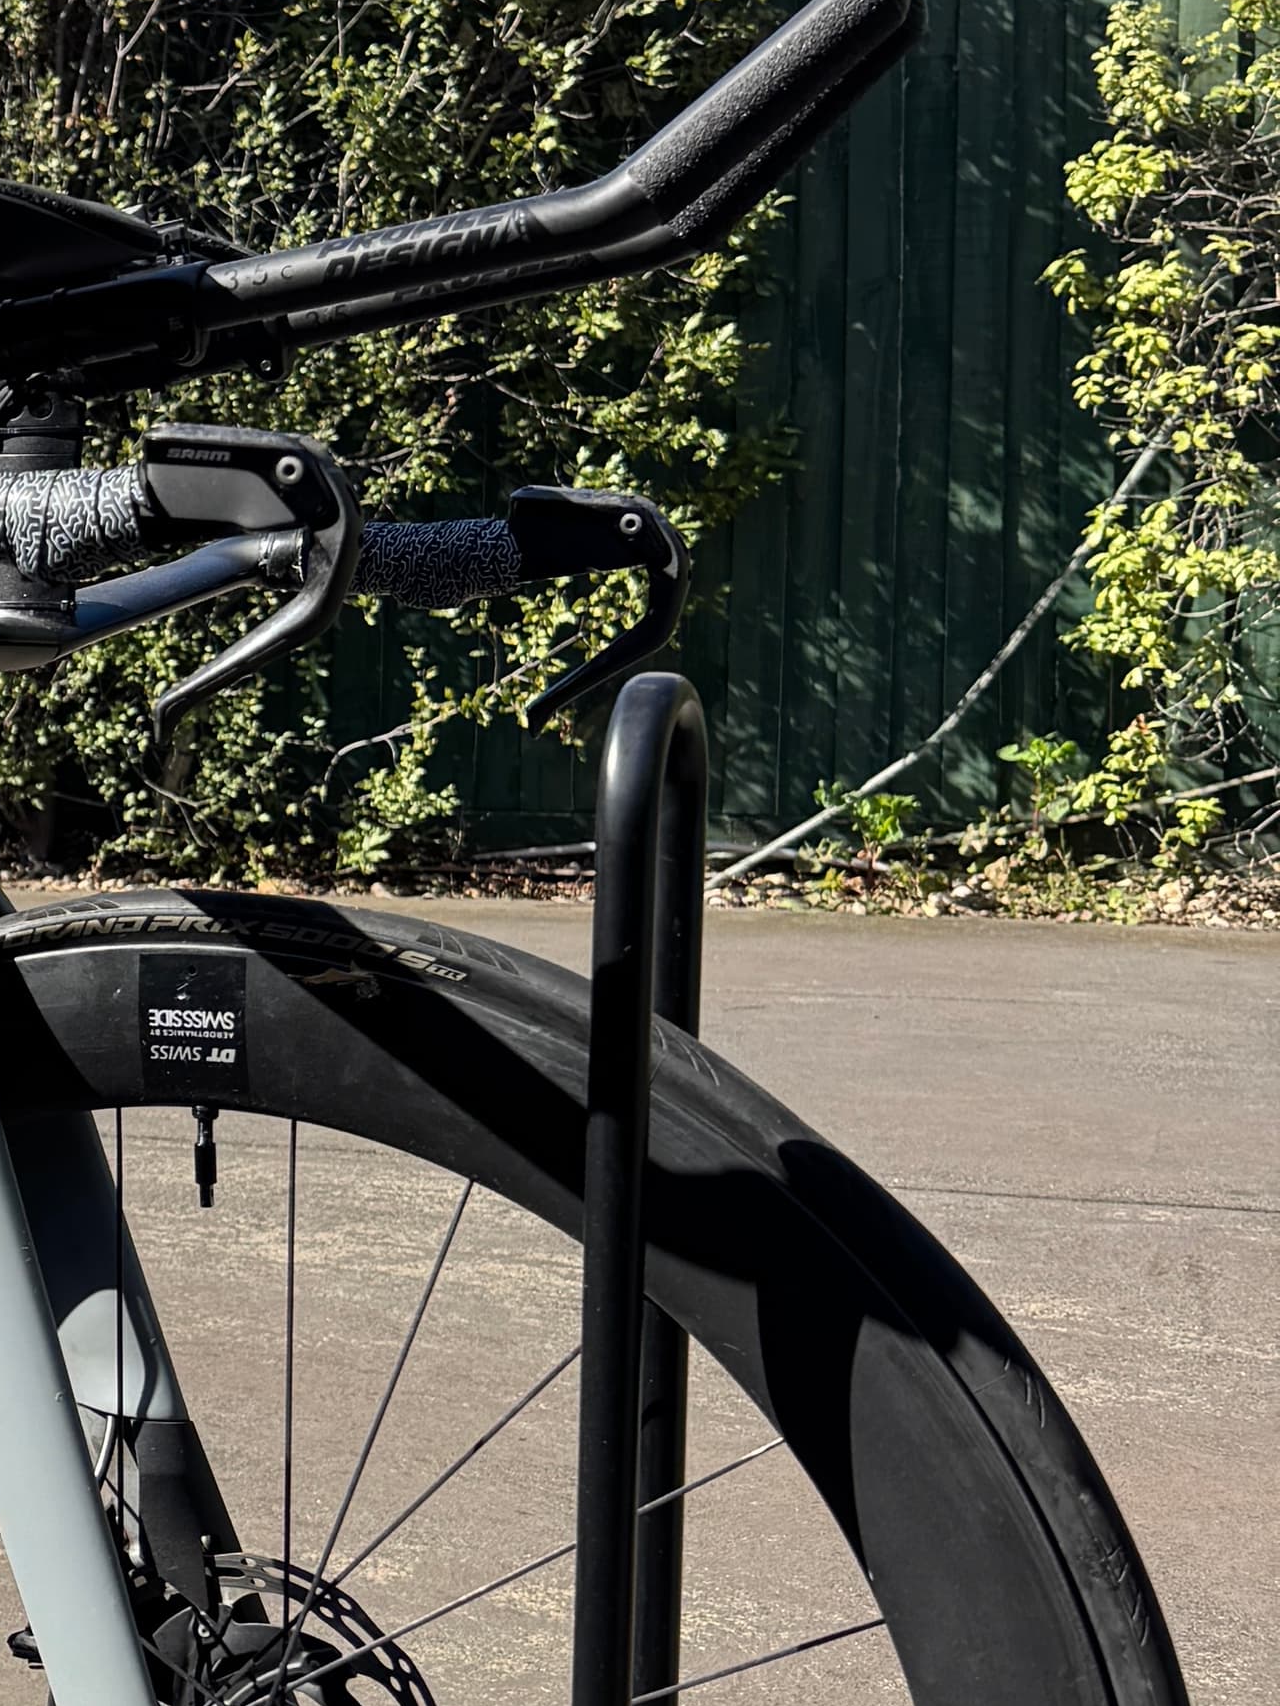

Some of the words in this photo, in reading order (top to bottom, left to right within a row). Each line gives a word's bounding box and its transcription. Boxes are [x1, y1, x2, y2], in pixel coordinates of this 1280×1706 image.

[317, 209, 508, 259] PROFILE
[323, 222, 504, 284] DESIGN
[166, 447, 231, 462] SRAM
[1, 915, 148, 950] GRAND
[147, 915, 260, 937] PRIX
[150, 1044, 203, 1062] SWISS
[206, 1047, 236, 1063] DT
